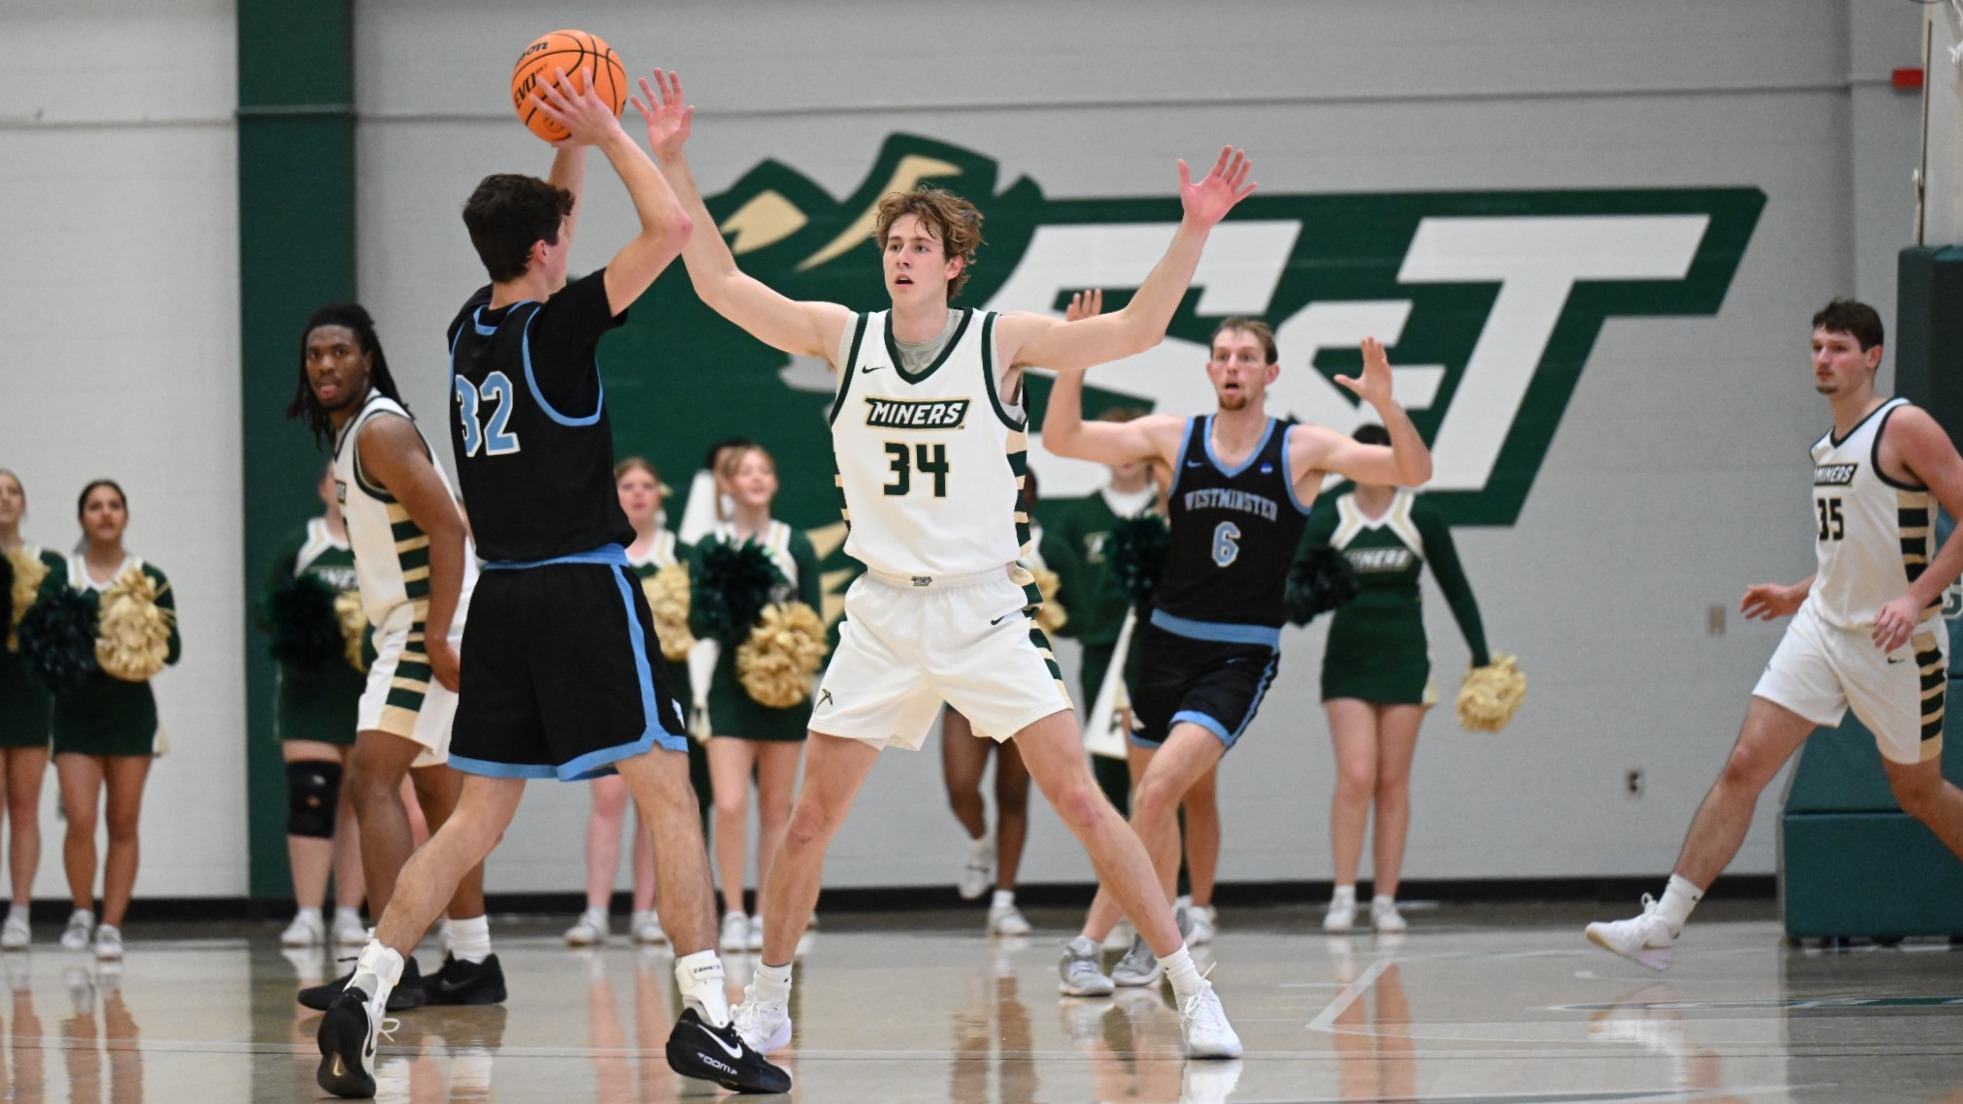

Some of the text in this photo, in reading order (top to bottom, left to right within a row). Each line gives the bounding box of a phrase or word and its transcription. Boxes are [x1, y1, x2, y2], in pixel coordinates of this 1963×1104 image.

[455, 370, 521, 457] 32
[869, 400, 964, 425] MINERS
[883, 441, 950, 498] 34
[1814, 465, 1853, 483] MINERS
[1184, 488, 1278, 522] WESTMINSTER
[1817, 498, 1844, 541] 35
[1212, 521, 1242, 568] 6
